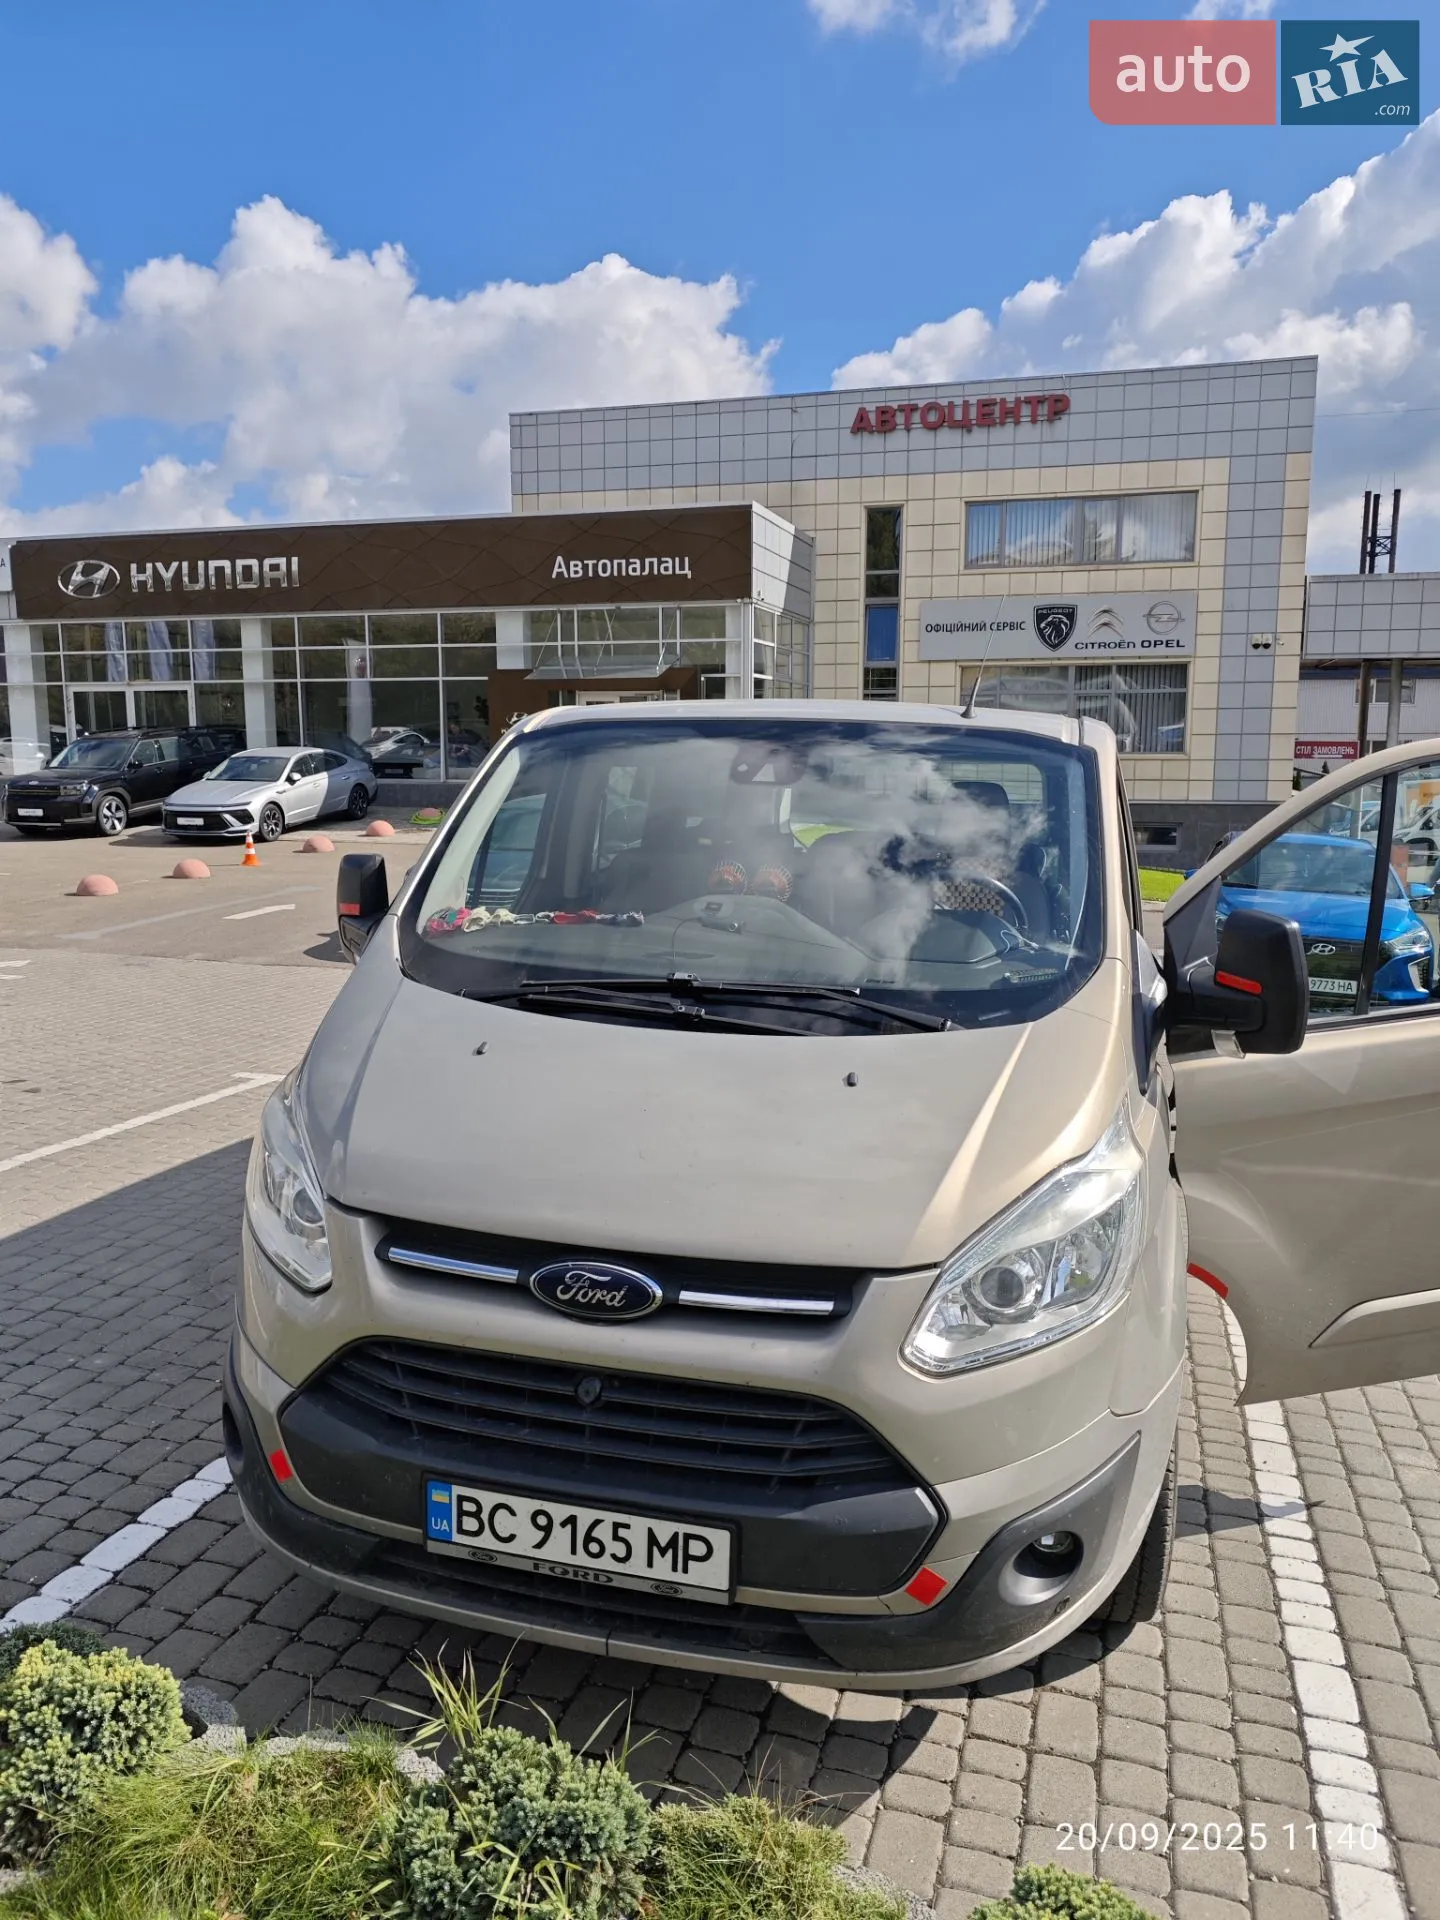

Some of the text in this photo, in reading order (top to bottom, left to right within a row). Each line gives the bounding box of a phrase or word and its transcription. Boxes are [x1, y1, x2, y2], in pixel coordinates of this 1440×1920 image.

[850, 393, 1071, 434] АВТОЦЕНТР
[130, 556, 300, 593] HYUNDAI
[551, 555, 692, 580] Автопалац
[925, 621, 1027, 635] ОФІЦІЙНИЙ СЕРВІС
[1140, 639, 1186, 649] OPEL
[1295, 745, 1355, 755] СТІЛ ЗАМОВЛЕНЬ
[1310, 979, 1336, 991] 9773
[556, 1270, 629, 1307] Ford
[431, 1516, 450, 1533] UA
[455, 1493, 714, 1575] BC 9165 MP
[532, 1562, 614, 1584] FORD
